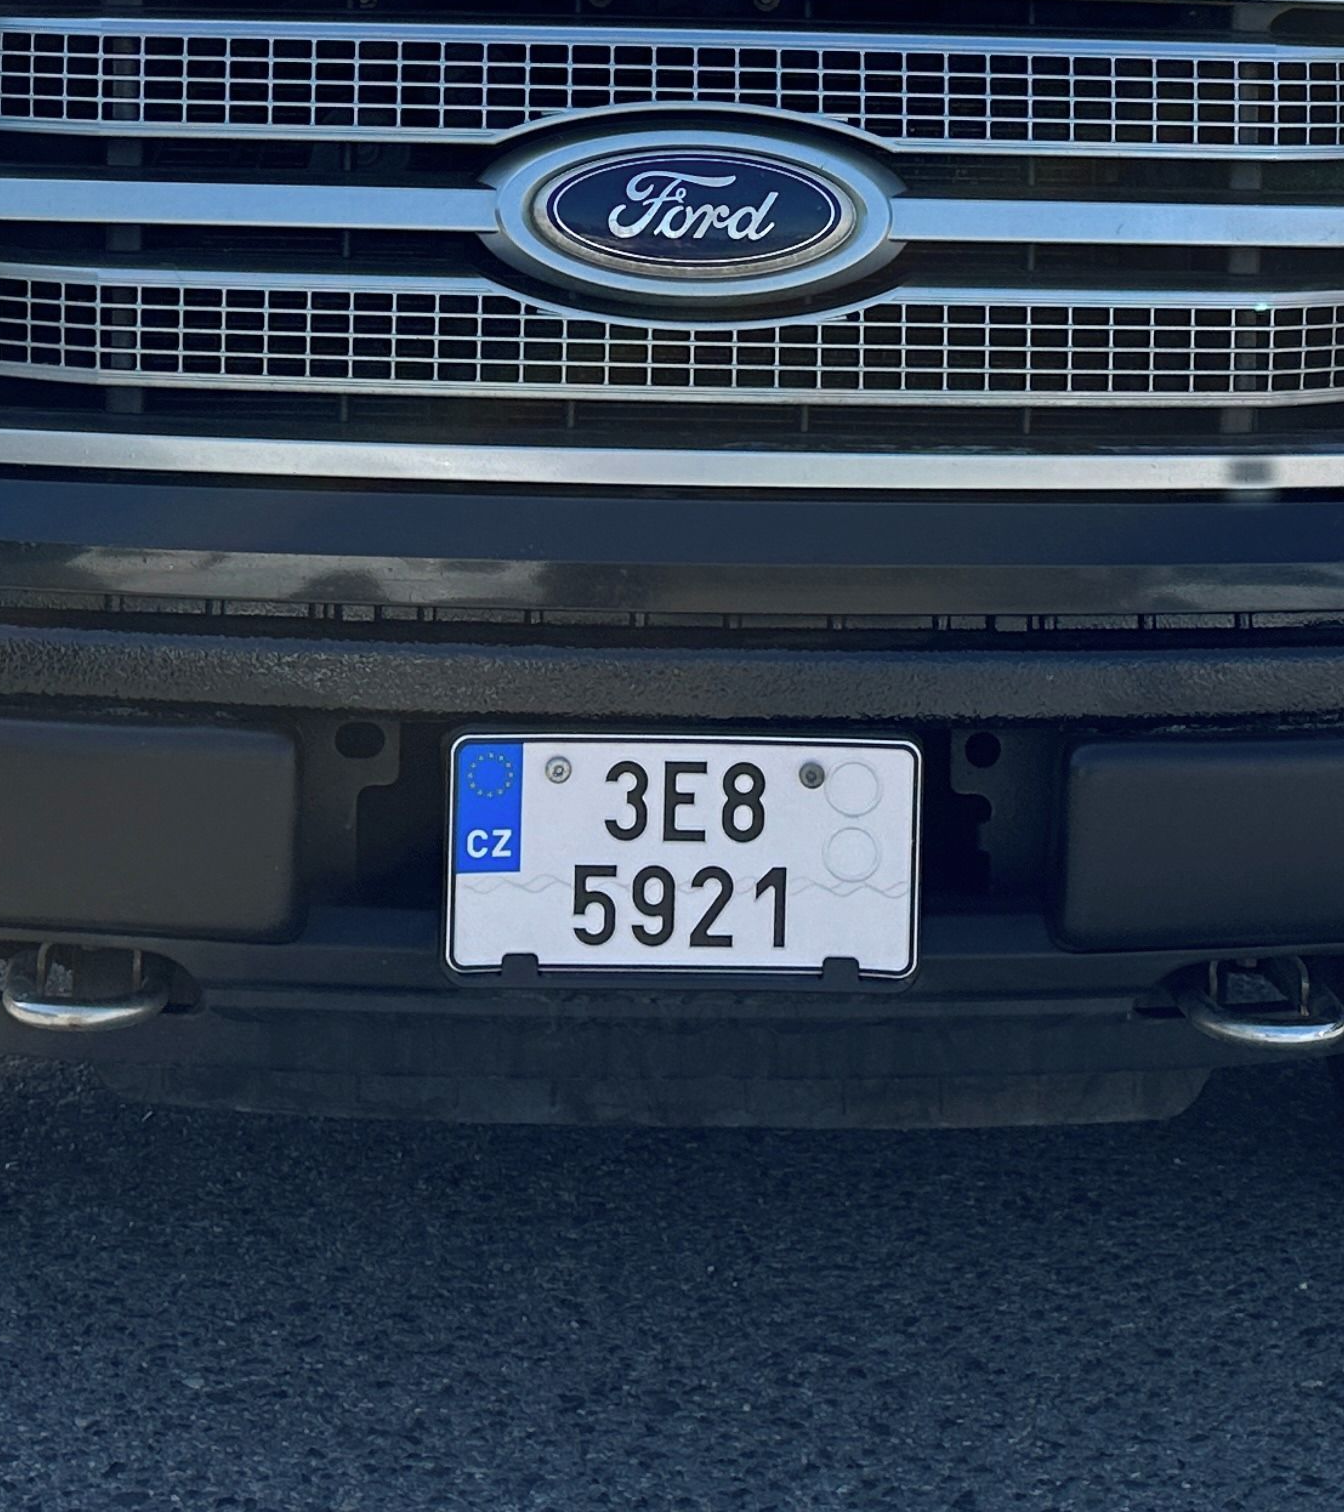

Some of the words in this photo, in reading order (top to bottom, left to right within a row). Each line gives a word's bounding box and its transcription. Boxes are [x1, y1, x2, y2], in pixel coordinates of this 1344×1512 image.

[608, 170, 779, 241] Ford
[604, 760, 766, 843] 3E8
[466, 829, 513, 859] CZ
[572, 864, 788, 948] 5921
